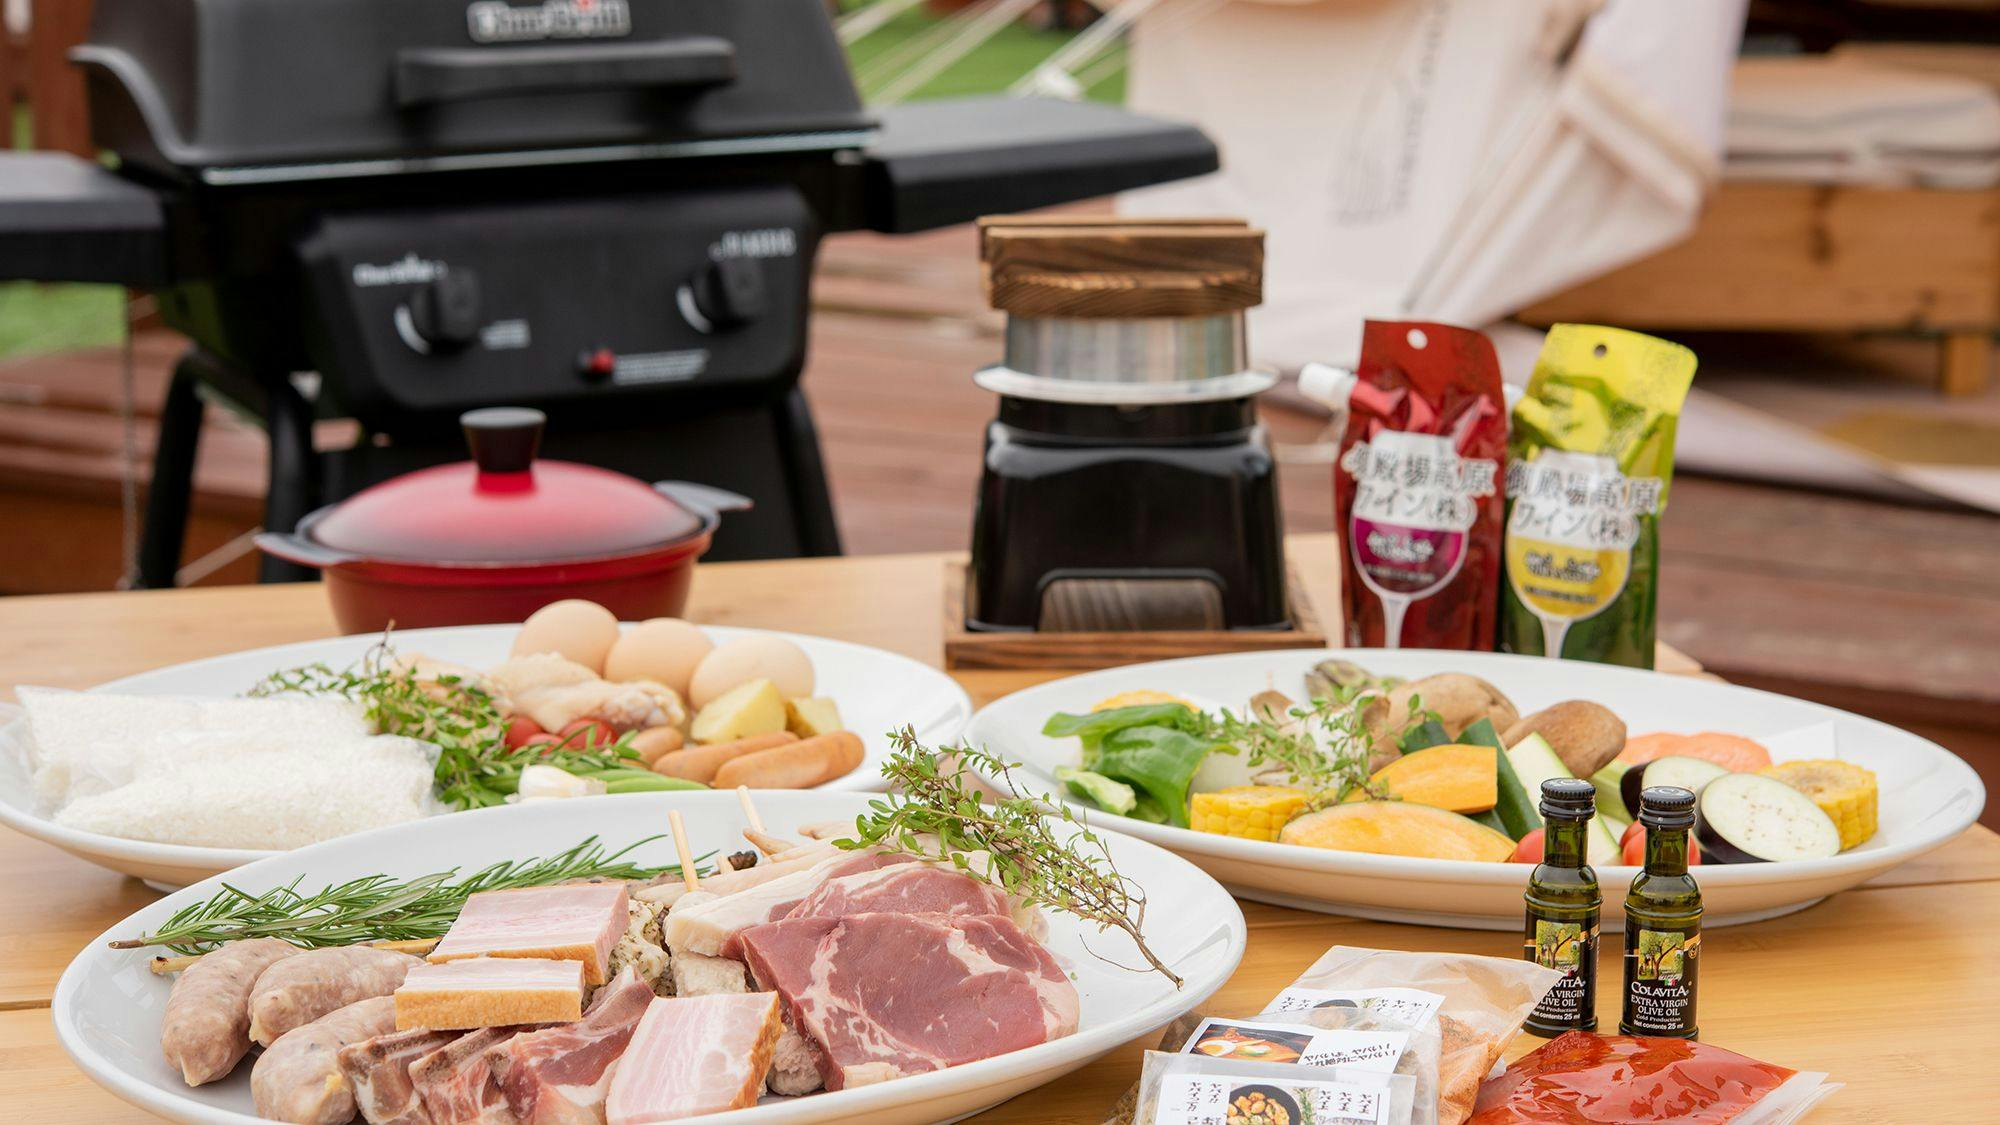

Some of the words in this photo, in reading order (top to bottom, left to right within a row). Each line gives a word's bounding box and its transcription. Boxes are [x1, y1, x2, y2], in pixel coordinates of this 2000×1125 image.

[1555, 976, 1585, 988] VITA
[1556, 989, 1584, 998] VIRGIN
[1631, 981, 1687, 997] COLAVITA
[1541, 997, 1560, 1006] LIVE
[1561, 999, 1577, 1007] OIL
[1631, 994, 1658, 1007] EXTRA
[1660, 998, 1688, 1007] VIRGIN
[1638, 1005, 1664, 1016] OLIVE
[1665, 1008, 1680, 1016] OIL
[1667, 1022, 1676, 1030] 25
